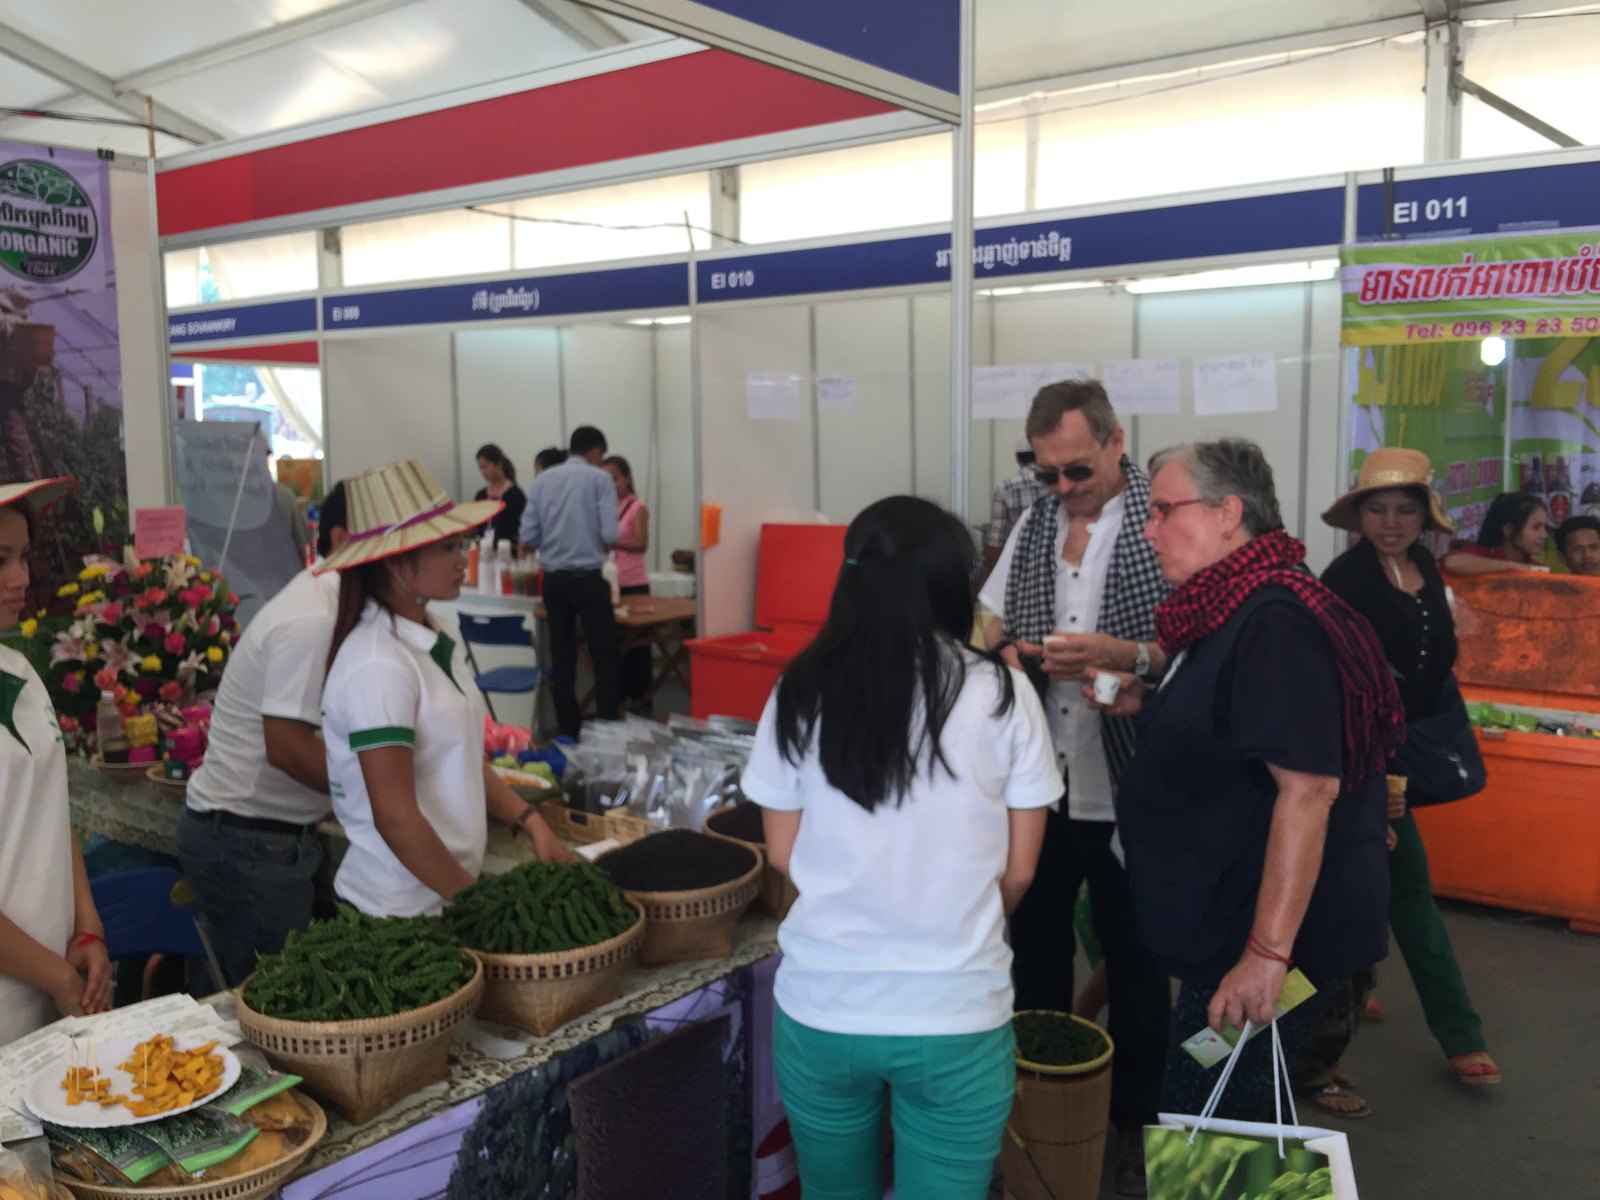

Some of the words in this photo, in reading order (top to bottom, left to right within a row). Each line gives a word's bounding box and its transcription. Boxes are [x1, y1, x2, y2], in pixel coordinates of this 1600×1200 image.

[1393, 202, 1417, 224] EI
[1425, 196, 1468, 221] 011
[0, 231, 79, 257] ORGANIC
[711, 273, 726, 289] EI
[728, 270, 754, 288] 010
[1406, 323, 1444, 339] Tel:
[1452, 320, 1491, 337] 096
[1501, 318, 1526, 335] 23
[1536, 317, 1561, 334] 23
